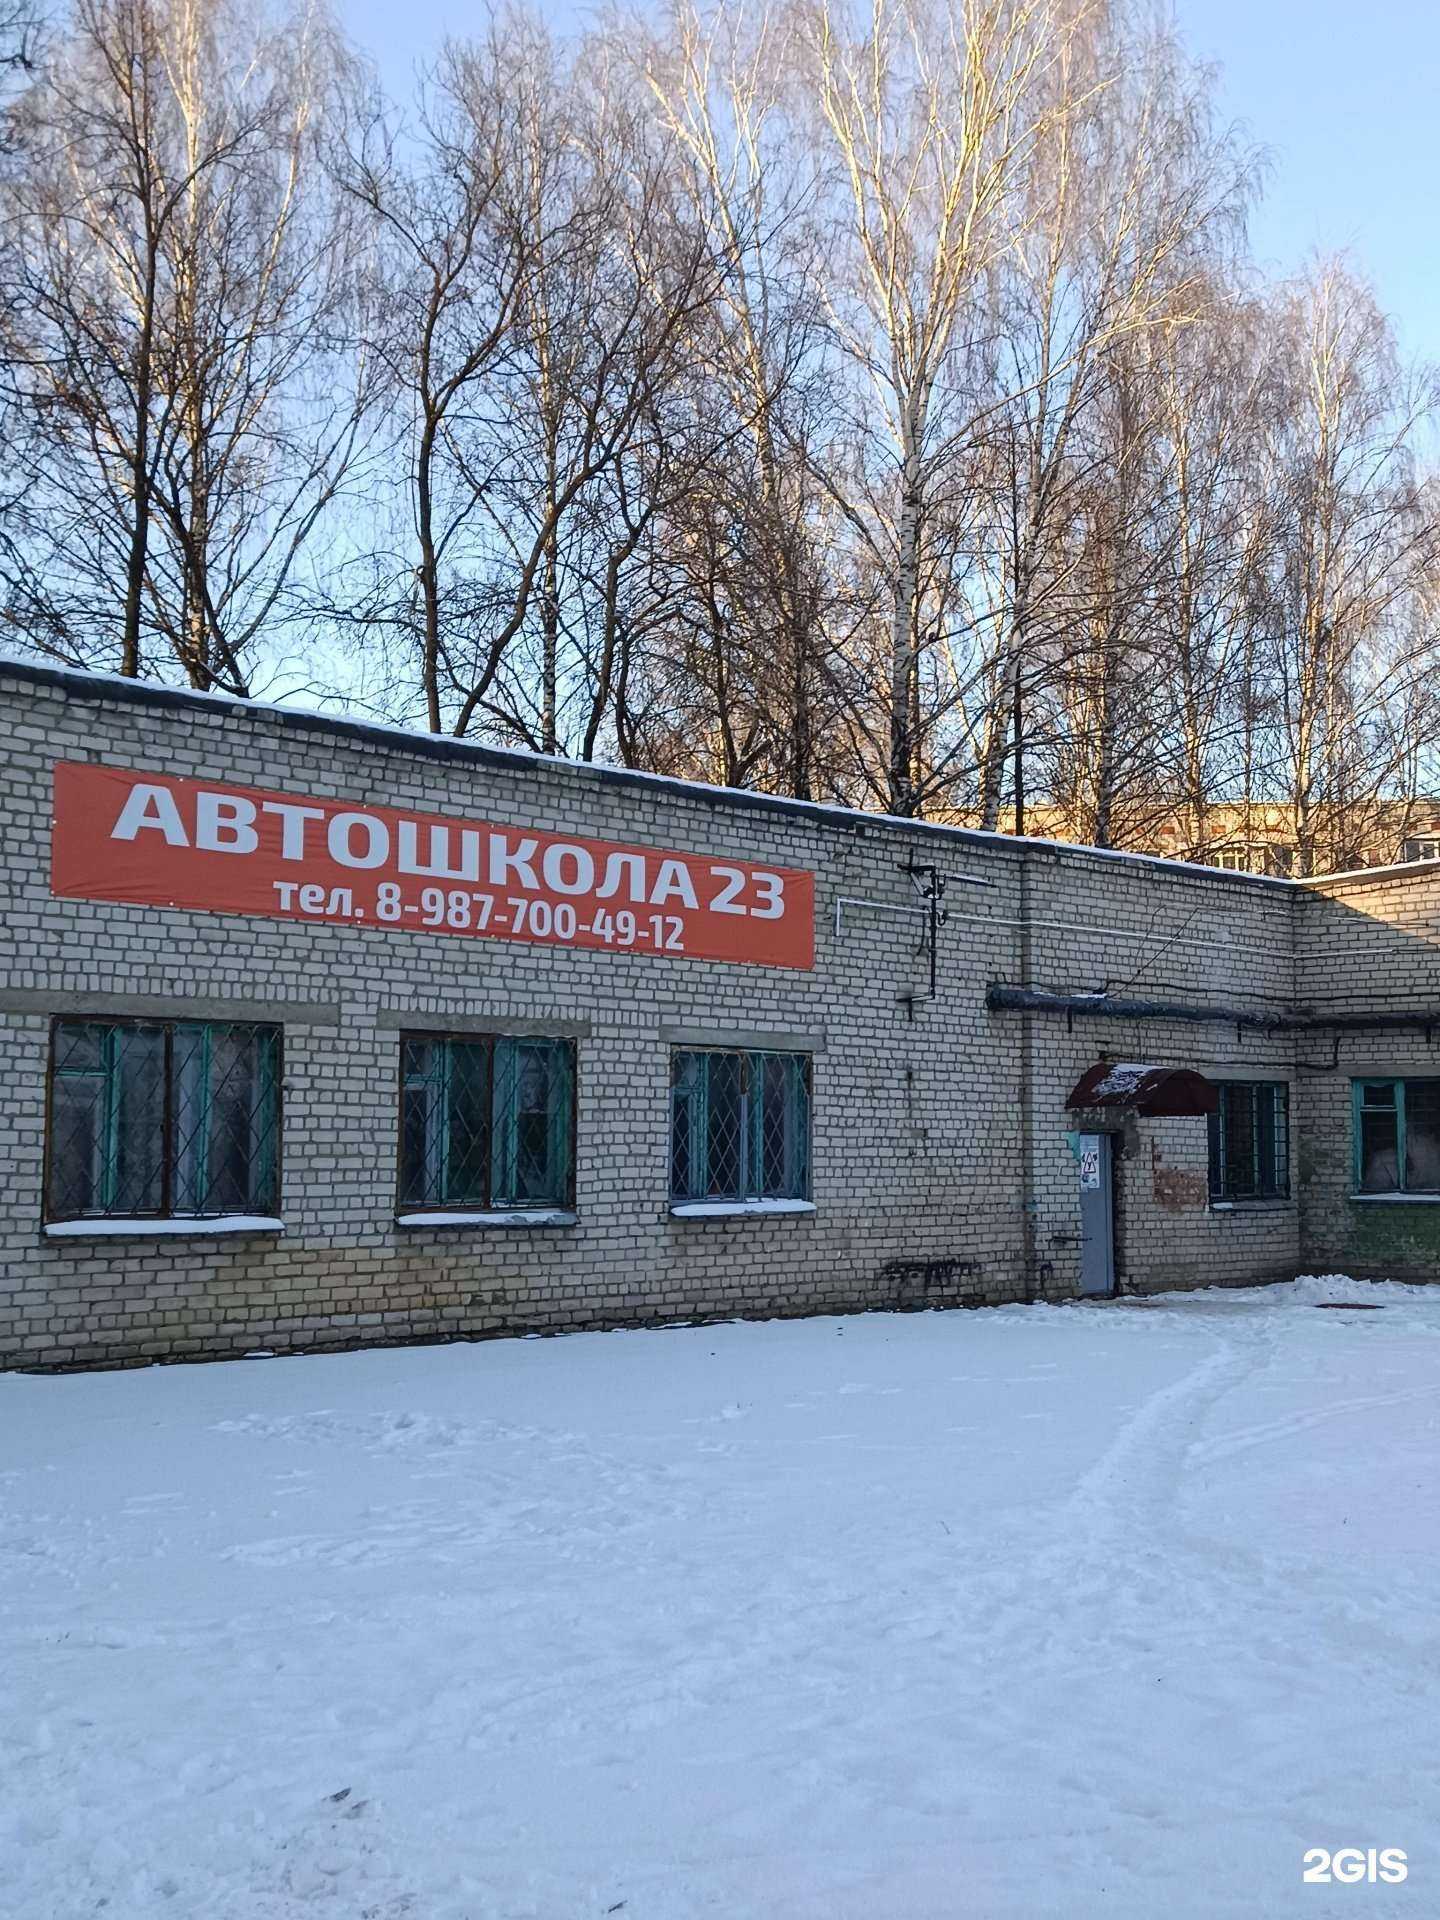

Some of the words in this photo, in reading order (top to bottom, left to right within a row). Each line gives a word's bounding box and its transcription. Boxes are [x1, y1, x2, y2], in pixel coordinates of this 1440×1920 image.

[110, 783, 699, 909] АВТОШКОЛА
[709, 866, 785, 919] 23
[273, 881, 364, 918] тел.
[376, 882, 684, 950] 8-987-700-49-12
